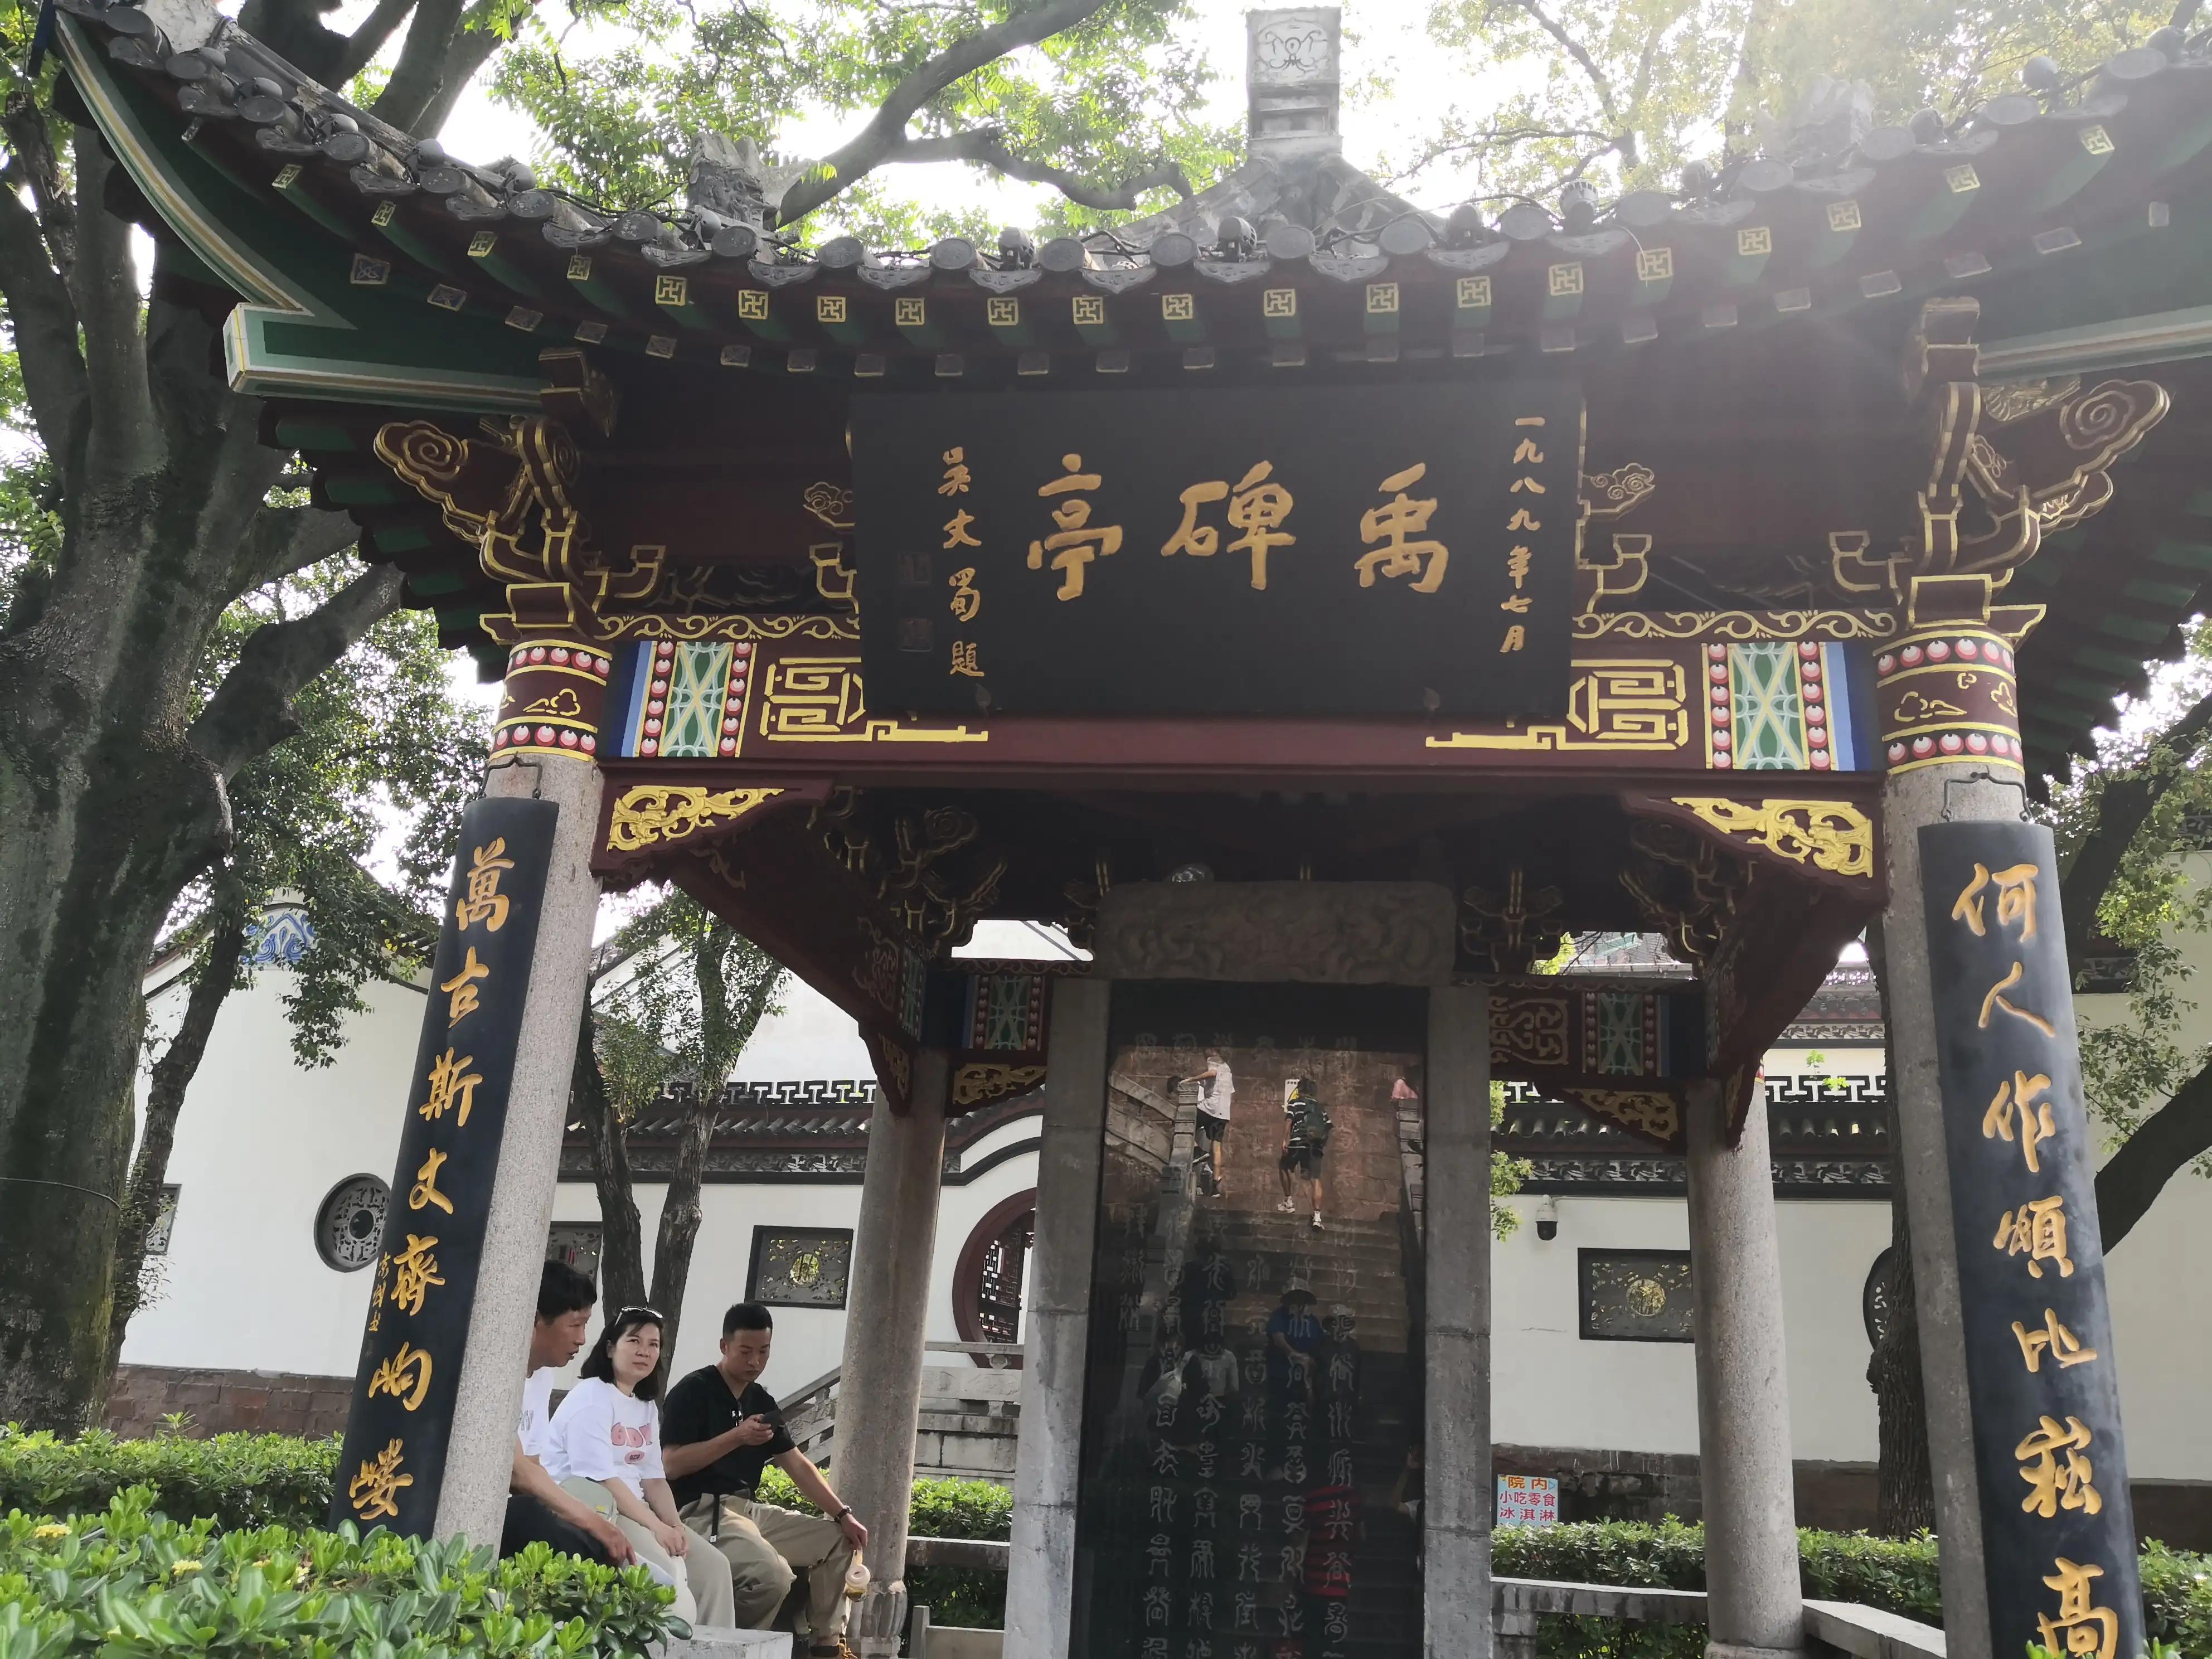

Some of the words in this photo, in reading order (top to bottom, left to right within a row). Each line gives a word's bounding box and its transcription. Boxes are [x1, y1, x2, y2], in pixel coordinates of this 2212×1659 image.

[1027, 453, 1449, 601] 禹碑亭
[1500, 416, 1546, 653] 一九八九年七月
[1508, 1477, 1547, 1490] 院内
[1500, 1491, 1555, 1507] 小吃零食
[1500, 1507, 1555, 1521] 冰淇淋
